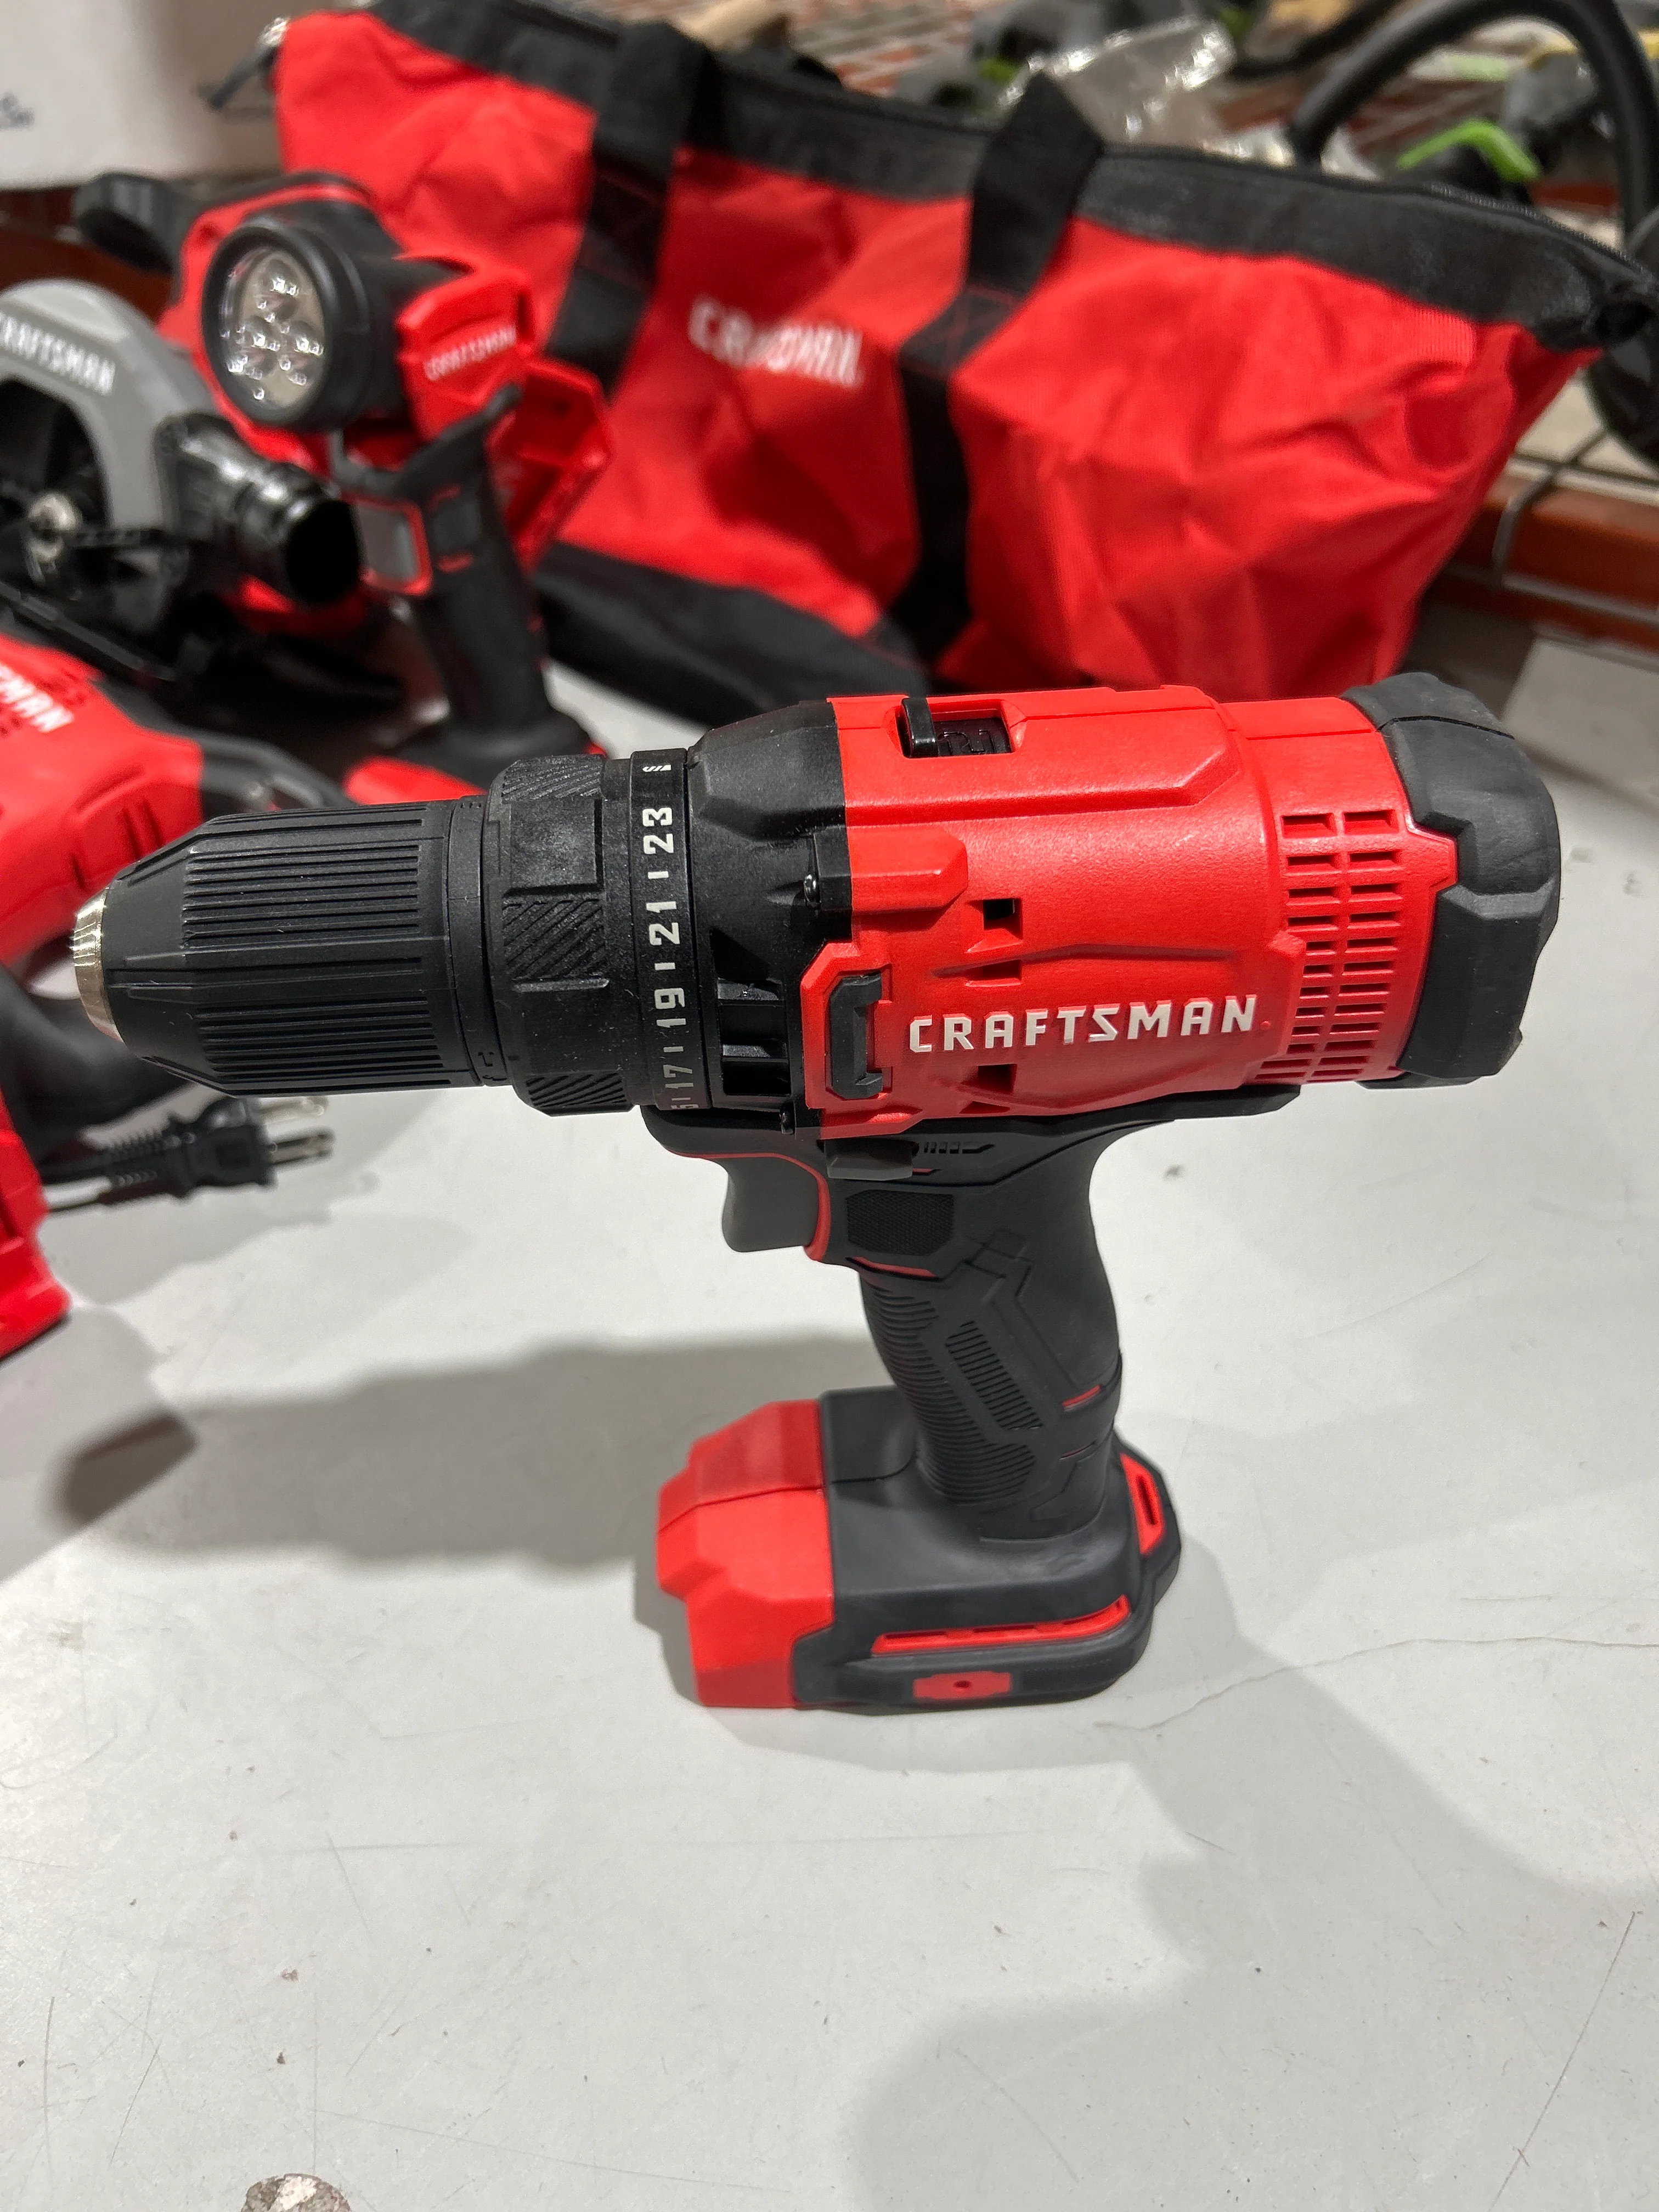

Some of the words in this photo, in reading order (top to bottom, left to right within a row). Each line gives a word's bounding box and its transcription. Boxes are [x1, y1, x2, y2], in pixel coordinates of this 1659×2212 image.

[0, 313, 116, 396] RAFTSMAN
[641, 806, 674, 855] 23
[645, 901, 680, 946] 21
[654, 988, 687, 1028] 19
[909, 994, 1257, 1053] CRAFTSMAN
[663, 1064, 694, 1089] 17
